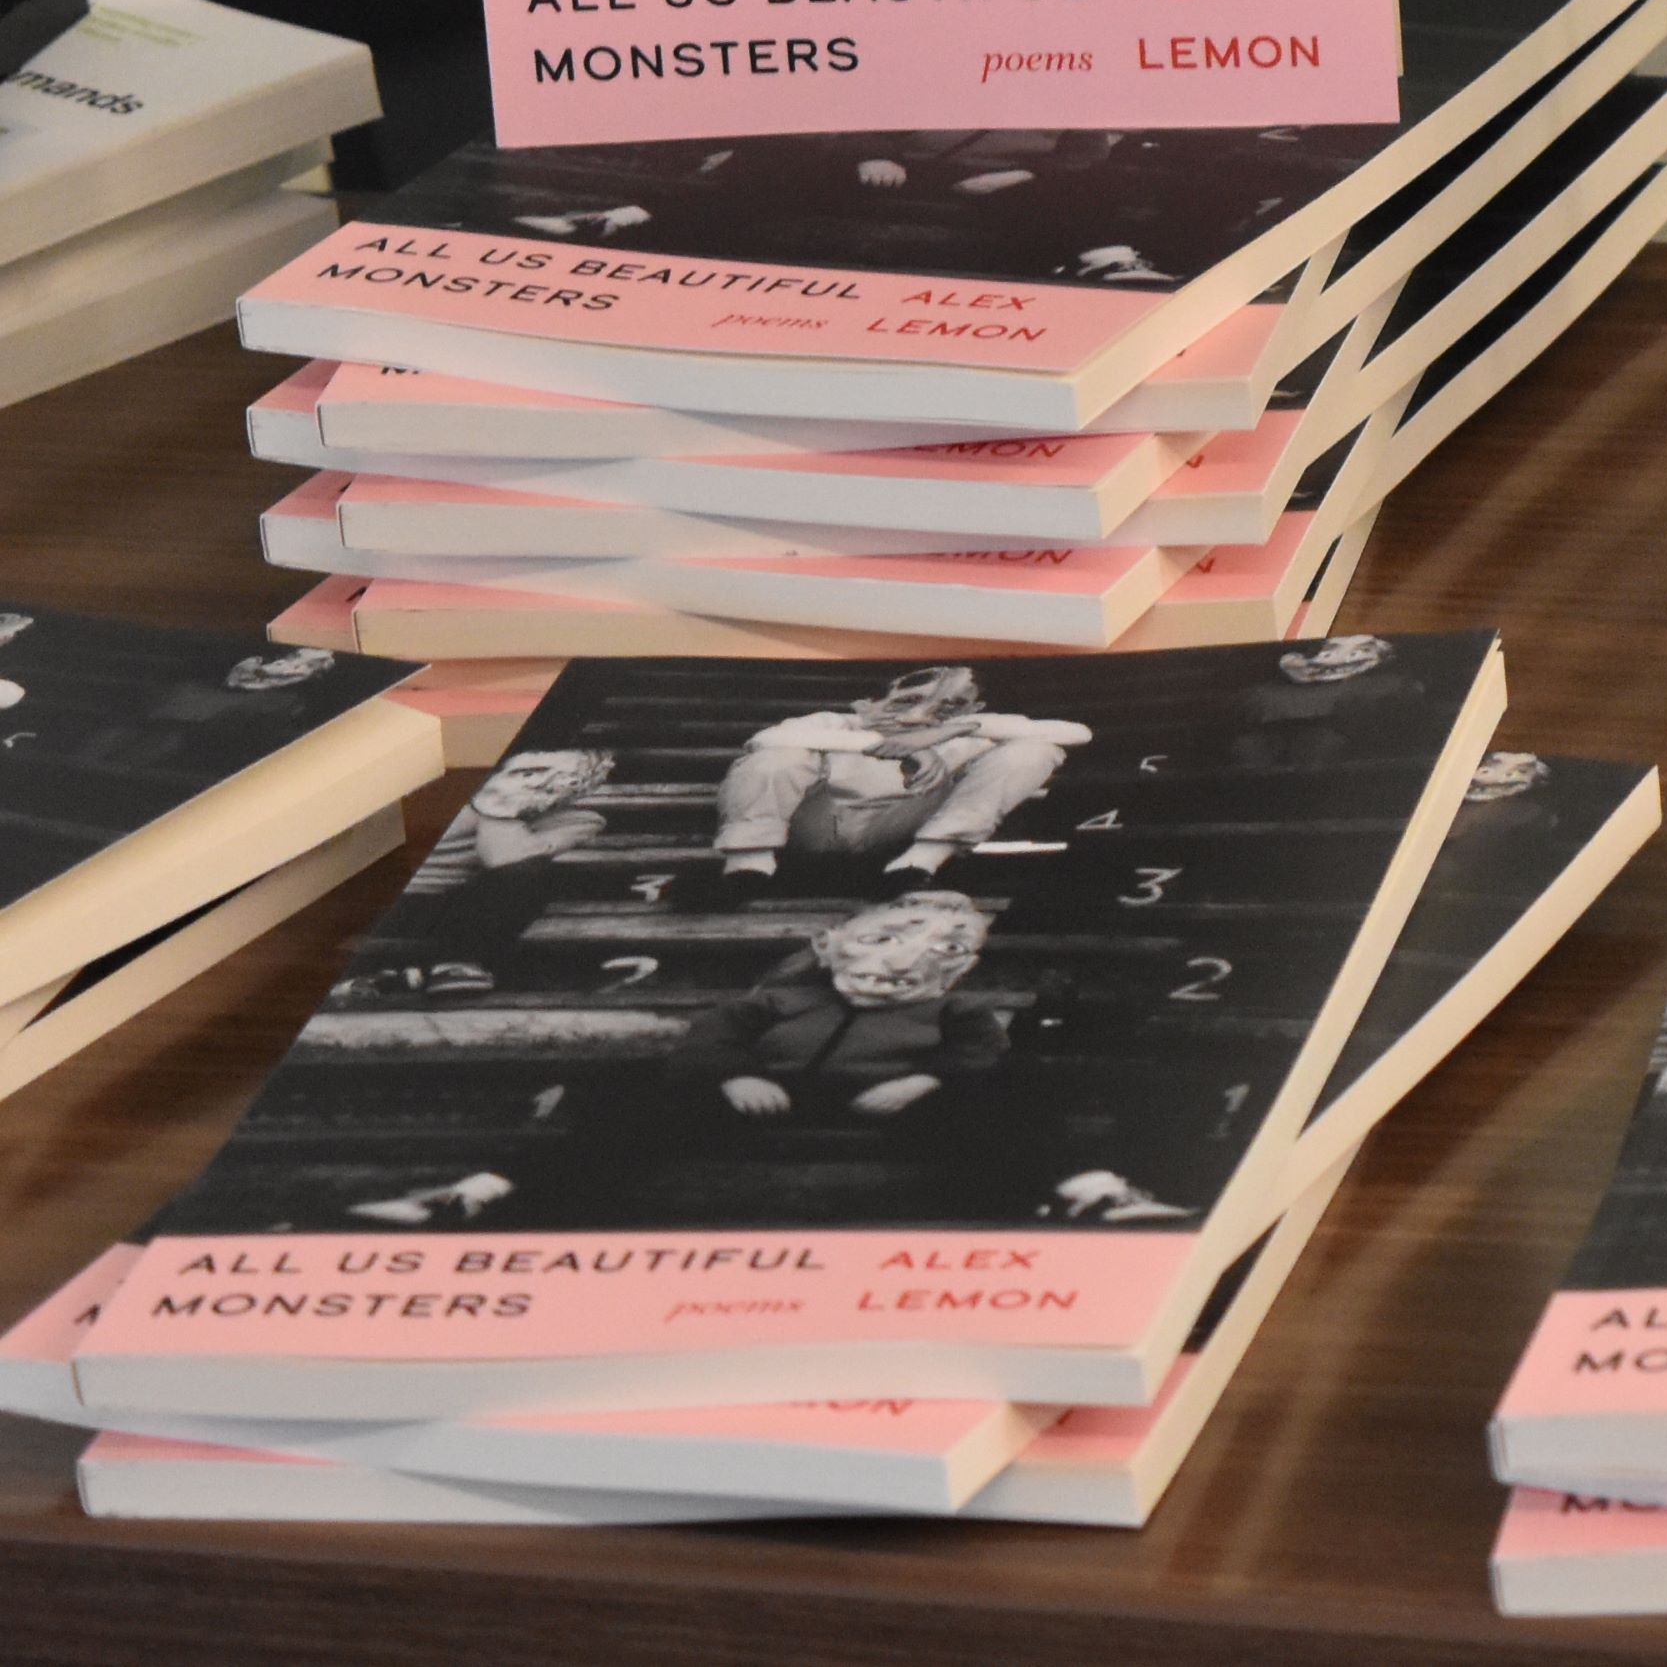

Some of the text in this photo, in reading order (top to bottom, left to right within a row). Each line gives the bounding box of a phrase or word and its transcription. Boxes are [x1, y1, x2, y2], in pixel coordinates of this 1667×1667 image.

[533, 36, 859, 84] MONSTERS
[1138, 35, 1320, 70] LEMON
[981, 52, 1093, 84] poems
[355, 237, 864, 302] ALL US BEAUTIFUL
[316, 266, 616, 312] MONSTERS
[901, 289, 1035, 311] ALEX
[865, 317, 1047, 342] LEMON
[177, 1248, 826, 1275] ALL US BEAUTIFUL
[879, 1250, 1040, 1270] ALEX
[152, 1293, 534, 1317] MONSTERS
[855, 1289, 1078, 1311] LEMON
